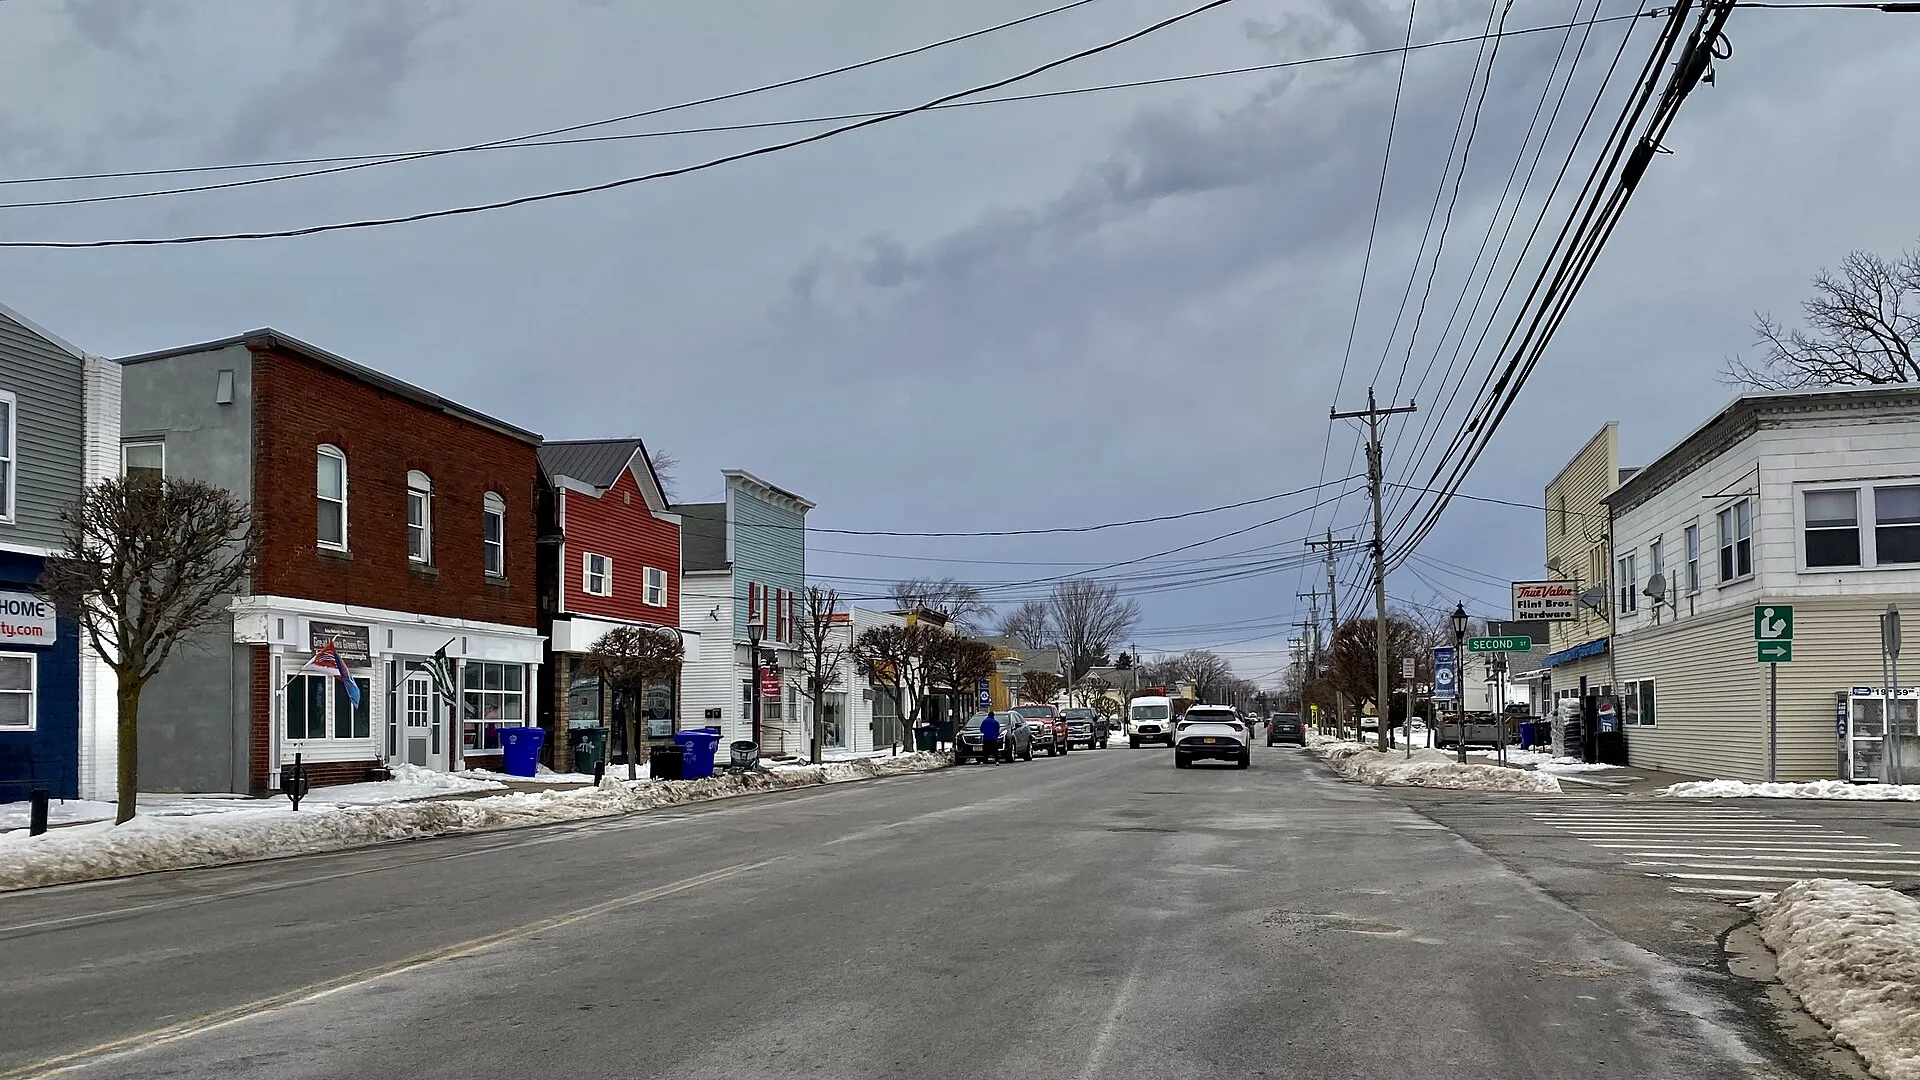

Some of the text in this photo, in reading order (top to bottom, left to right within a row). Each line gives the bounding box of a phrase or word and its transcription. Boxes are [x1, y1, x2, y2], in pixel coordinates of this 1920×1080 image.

[1517, 585, 1572, 598] True Value
[1518, 600, 1542, 608] Flint
[1520, 611, 1571, 619] Hardware
[1473, 640, 1513, 649] SECOND
